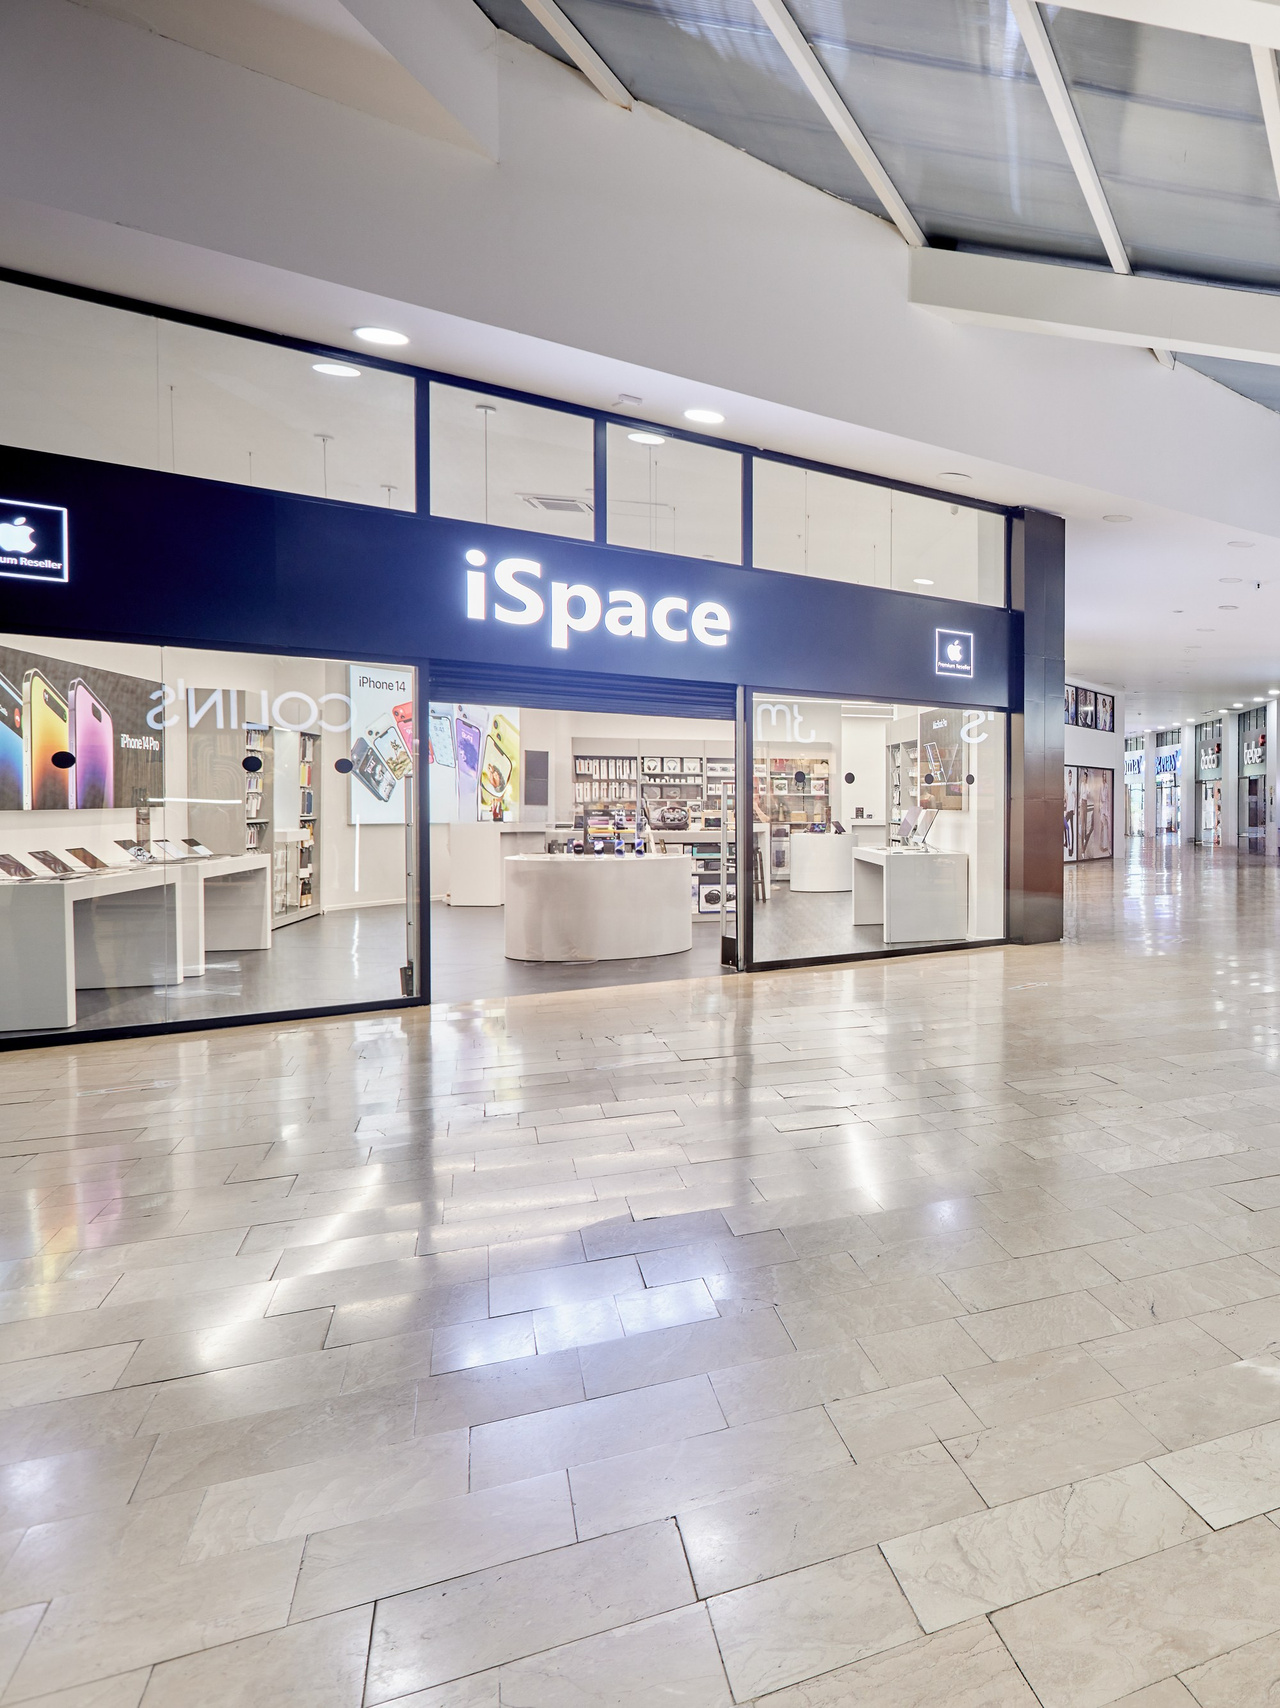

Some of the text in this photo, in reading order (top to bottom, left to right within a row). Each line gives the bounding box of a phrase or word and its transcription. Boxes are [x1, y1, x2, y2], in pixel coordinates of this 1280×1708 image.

[19, 556, 63, 570] Reseller
[464, 549, 732, 649] iSpace
[358, 676, 406, 692] iPhone 14
[120, 733, 143, 750] iPhone
